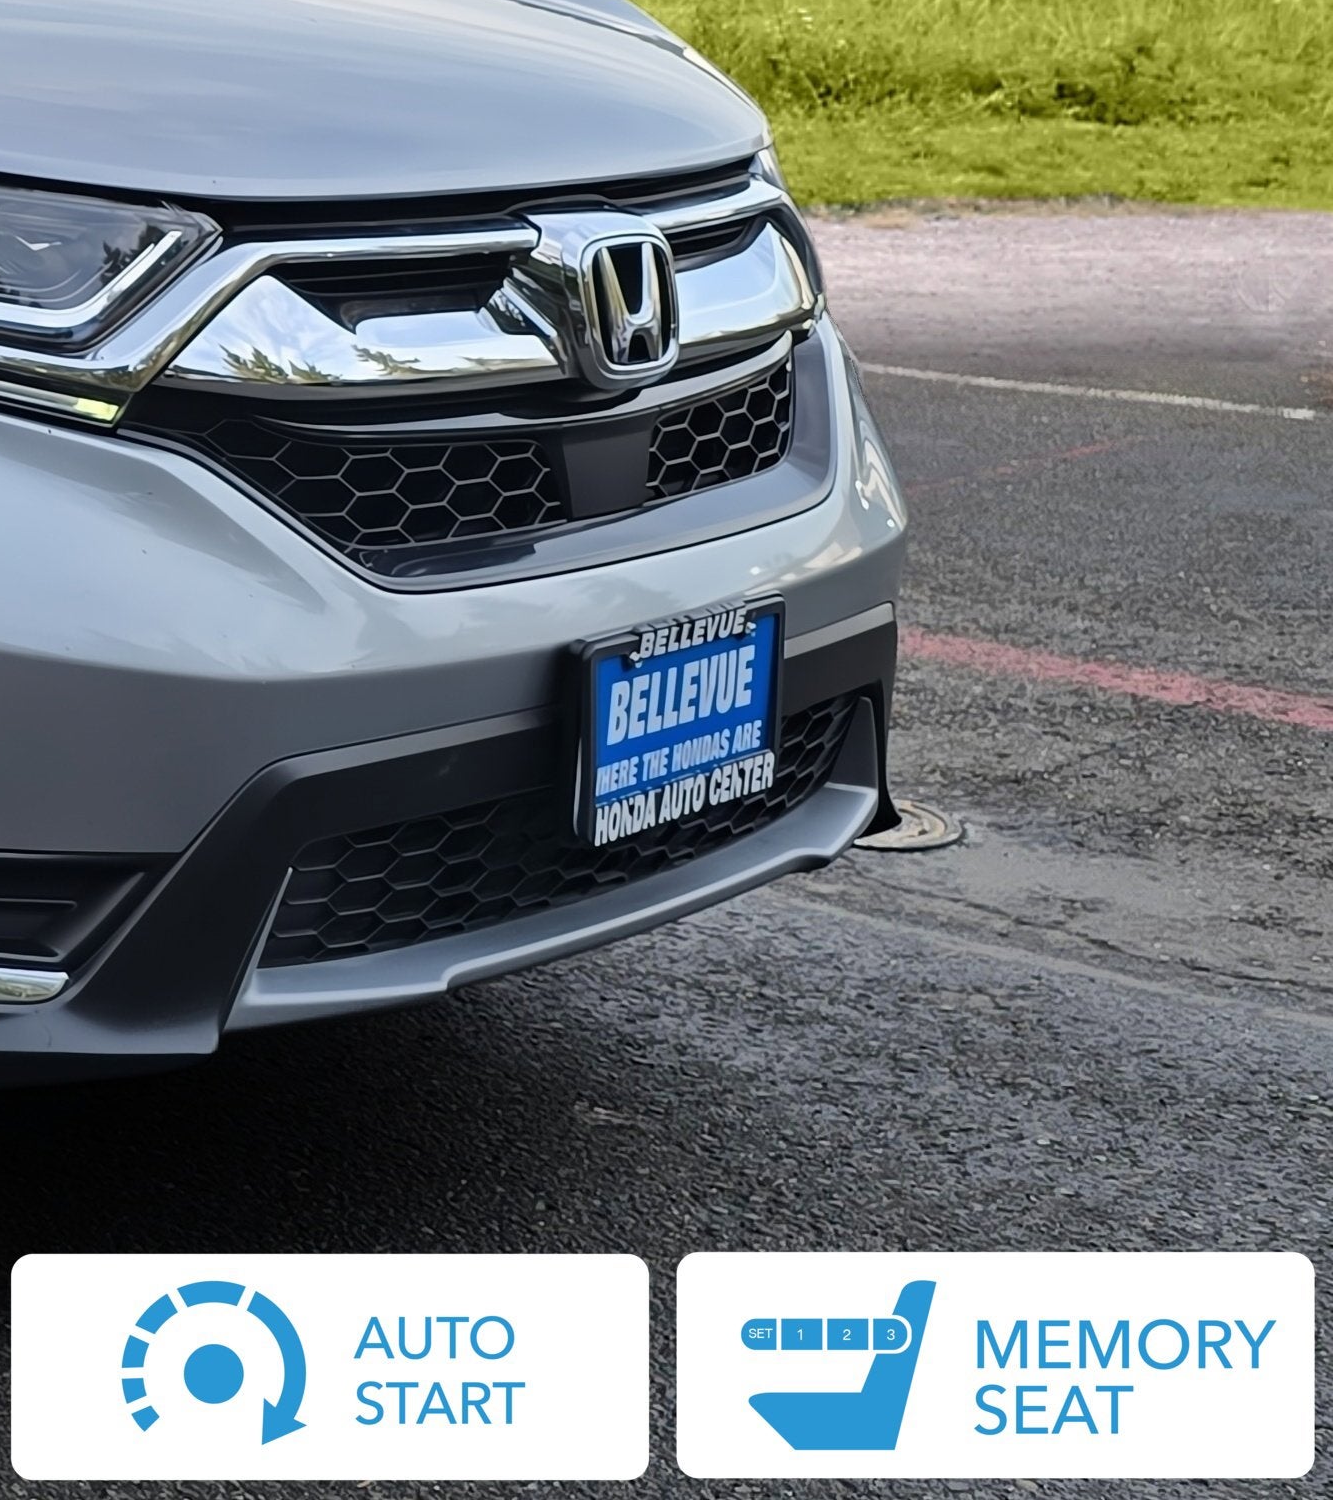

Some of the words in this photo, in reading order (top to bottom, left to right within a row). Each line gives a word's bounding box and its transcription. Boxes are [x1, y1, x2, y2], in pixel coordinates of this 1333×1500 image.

[639, 606, 748, 659] BELLEVUE
[606, 644, 756, 746] BELLEVUE
[642, 746, 670, 782] THE
[671, 727, 731, 773] HONDAS
[731, 719, 763, 755] ARE
[594, 793, 656, 847] HONDA
[658, 773, 707, 825] AUTO
[708, 751, 776, 806] CENTER
